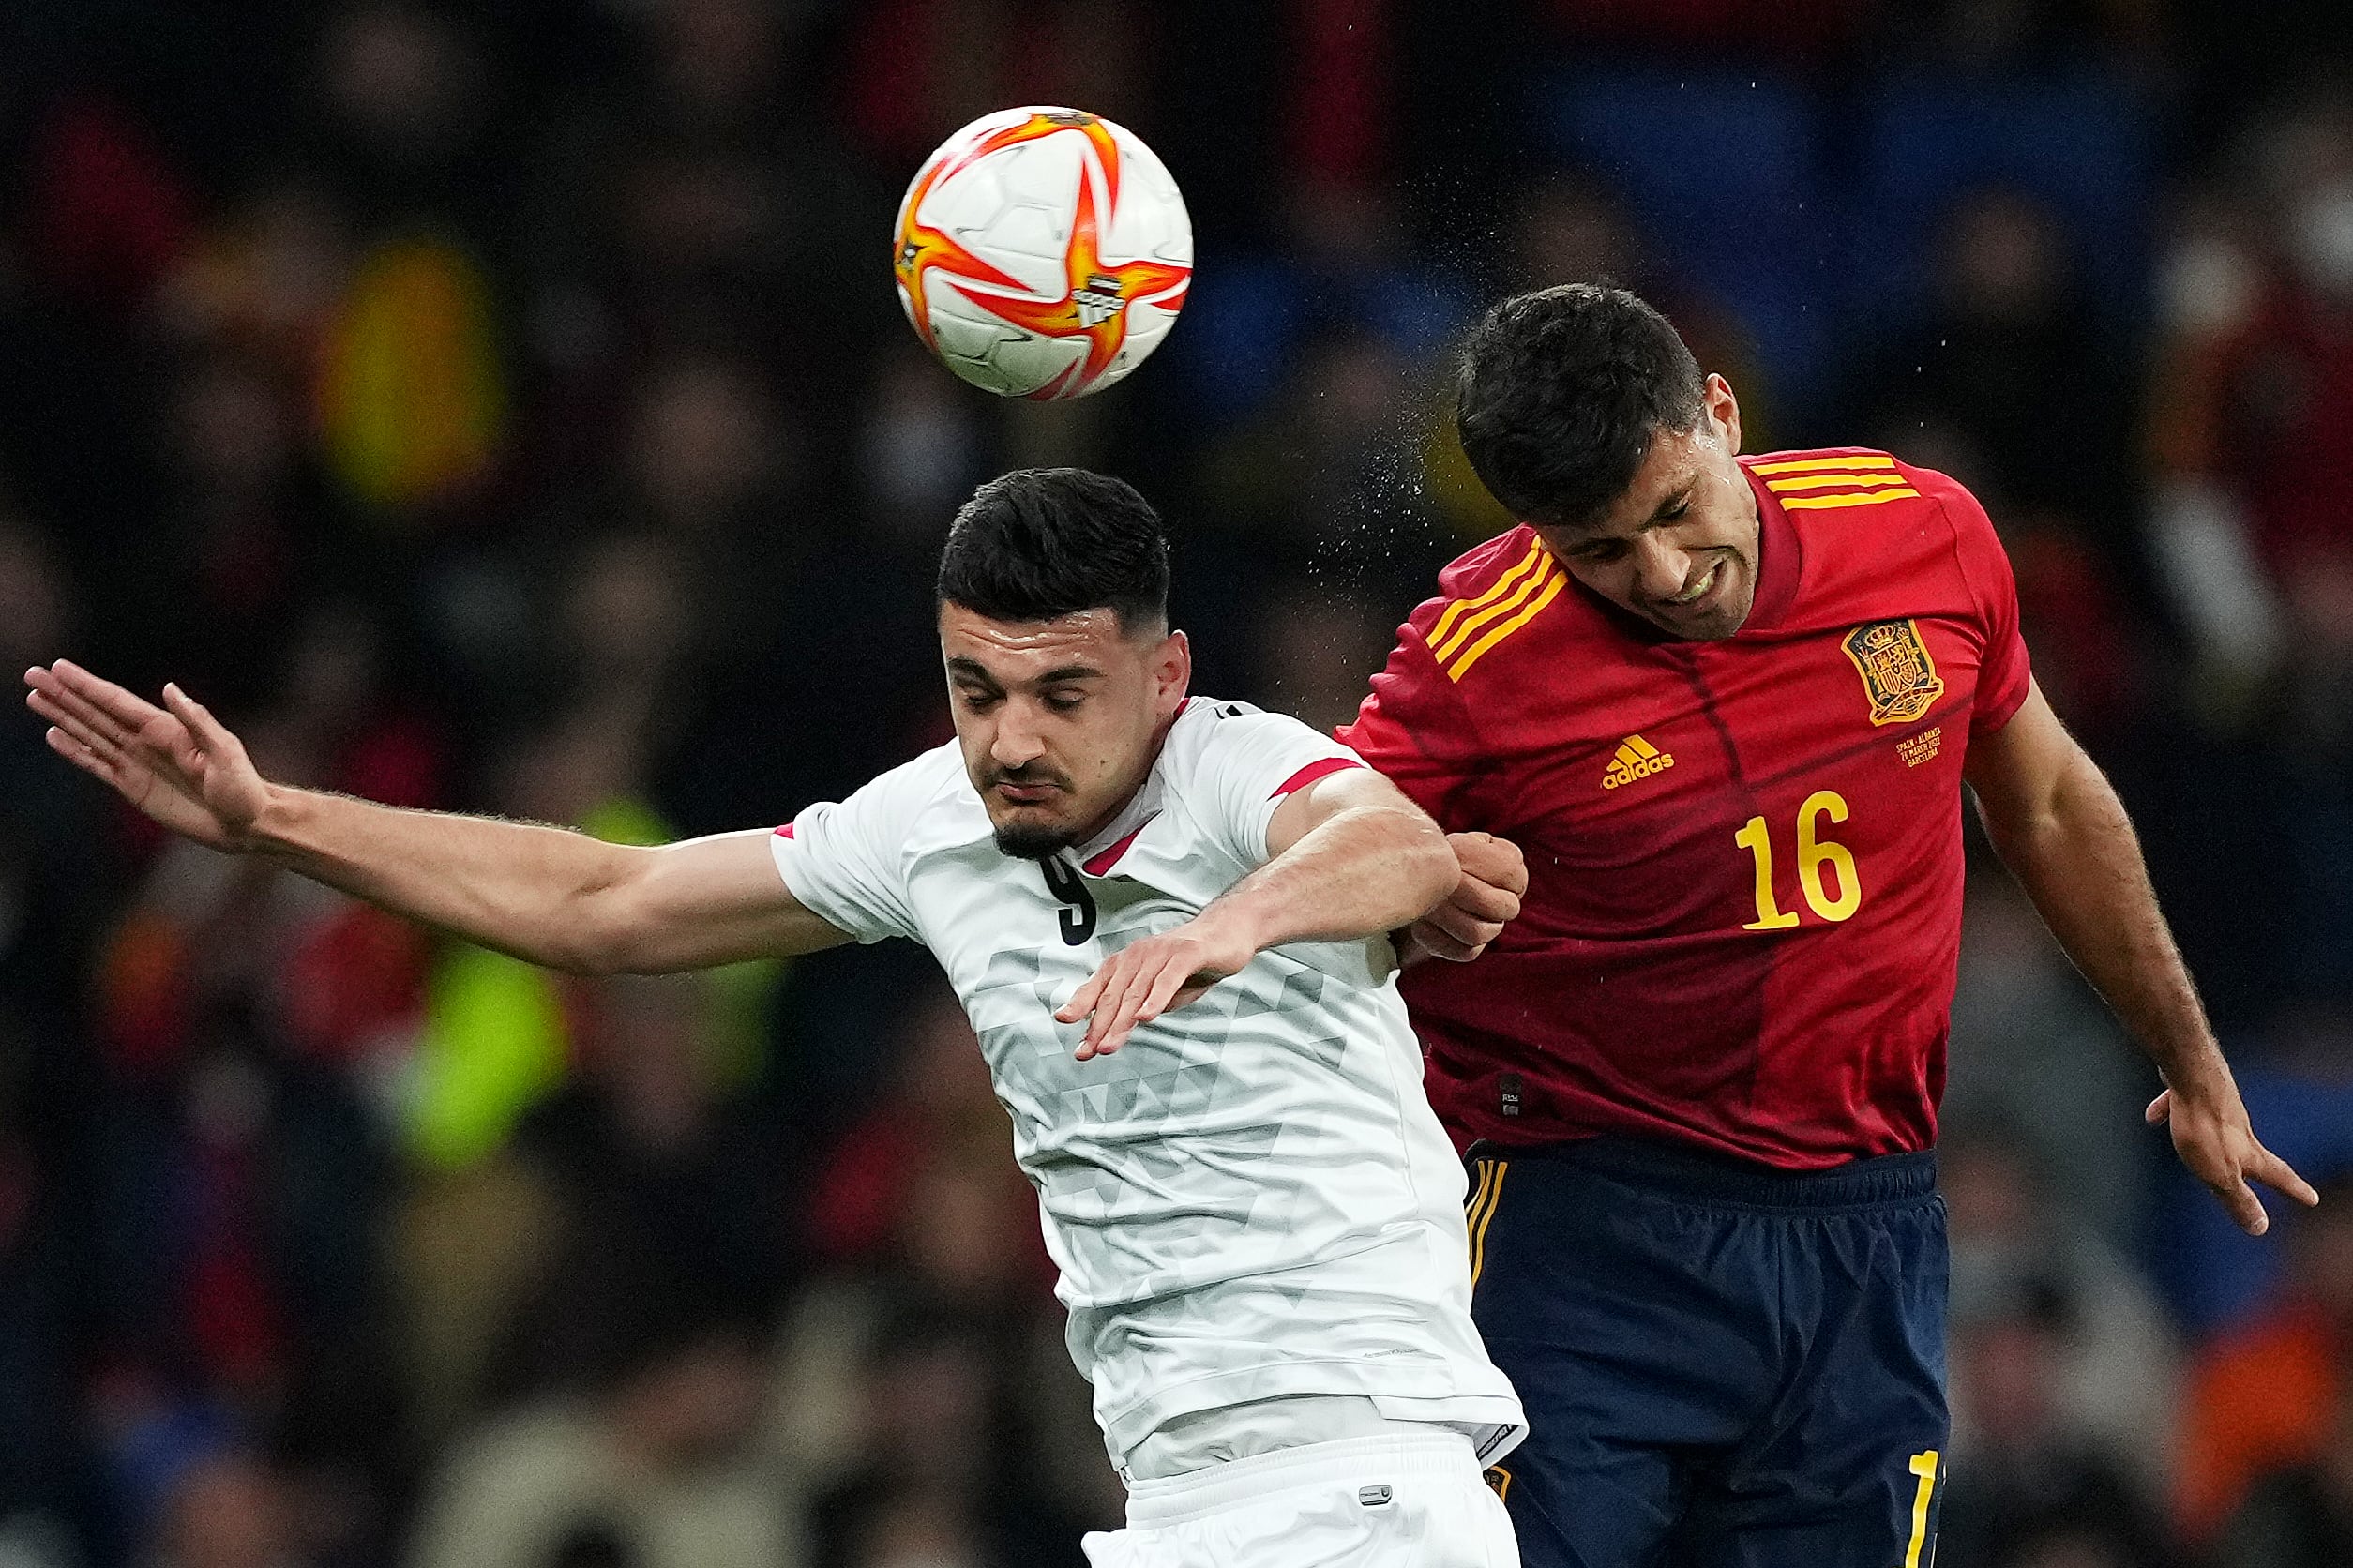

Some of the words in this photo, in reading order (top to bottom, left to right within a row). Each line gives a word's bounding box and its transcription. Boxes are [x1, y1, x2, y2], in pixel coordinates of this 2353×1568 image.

[1895, 738, 1914, 753] SPAIN
[1918, 727, 1941, 744] ALBANIA
[1908, 743, 1928, 758] MARCH
[1602, 751, 1675, 790] adidas
[1908, 747, 1938, 767] BARCELONA
[1734, 790, 1863, 930] 16
[1039, 853, 1097, 946] 9
